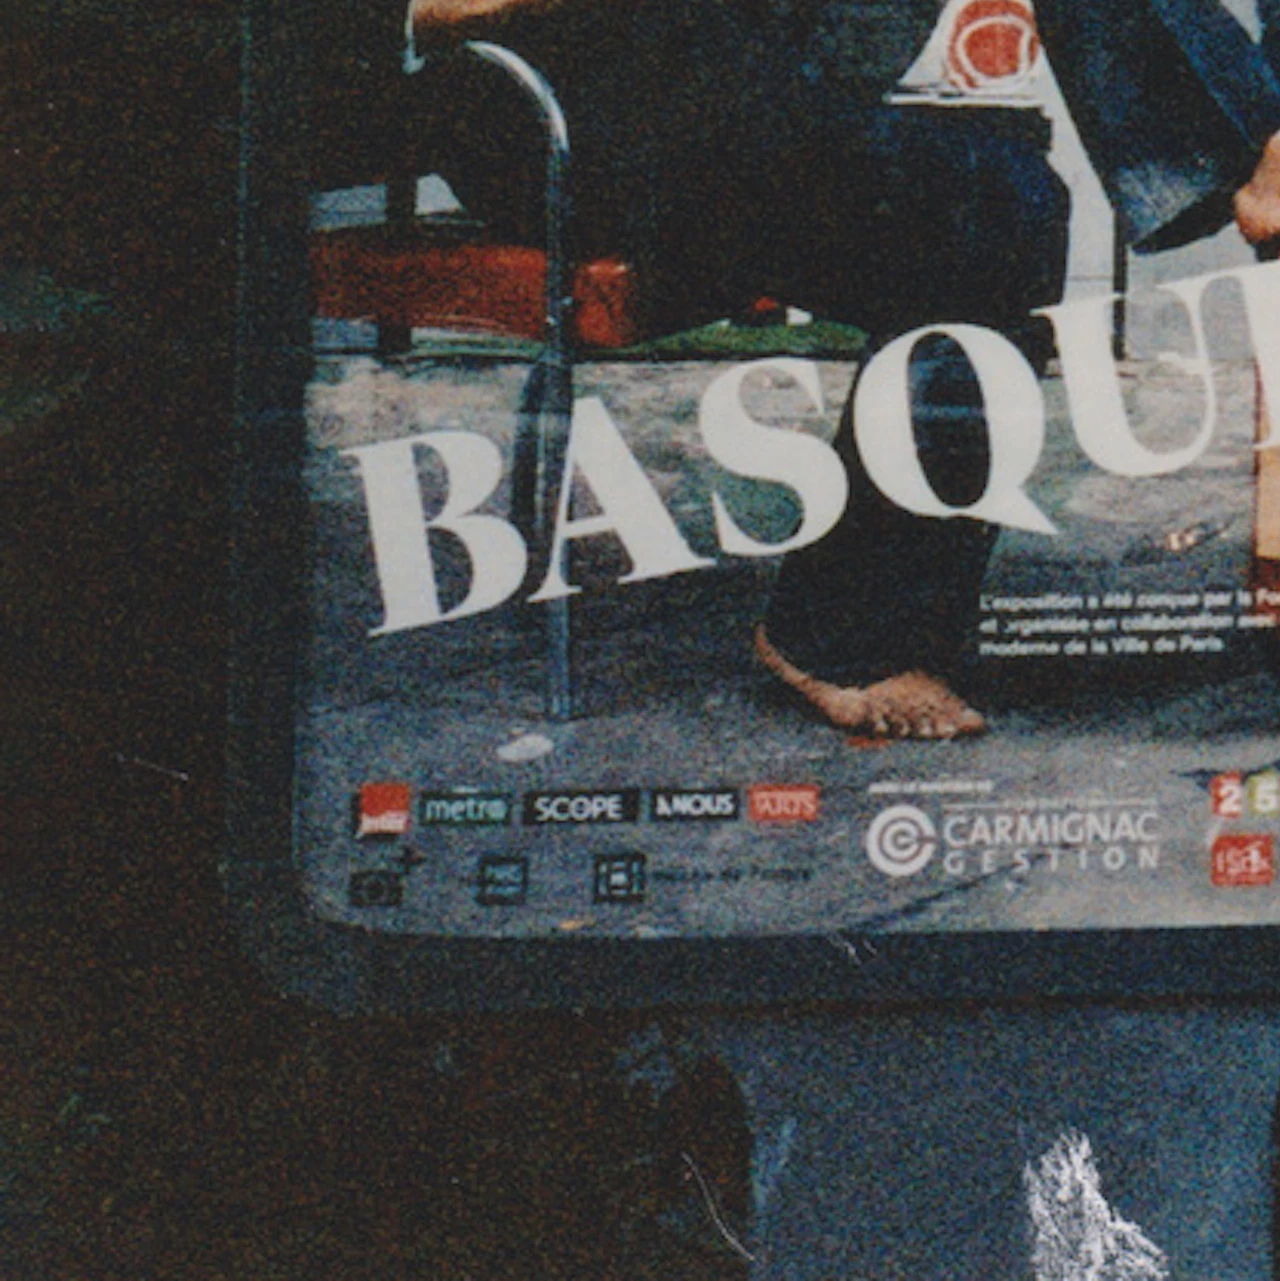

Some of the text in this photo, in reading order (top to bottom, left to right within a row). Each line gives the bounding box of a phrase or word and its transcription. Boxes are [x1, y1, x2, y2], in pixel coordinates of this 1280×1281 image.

[534, 795, 624, 821] SCOPE
[942, 812, 1159, 848] CARMIGNAC
[942, 846, 1159, 876] GESTION
